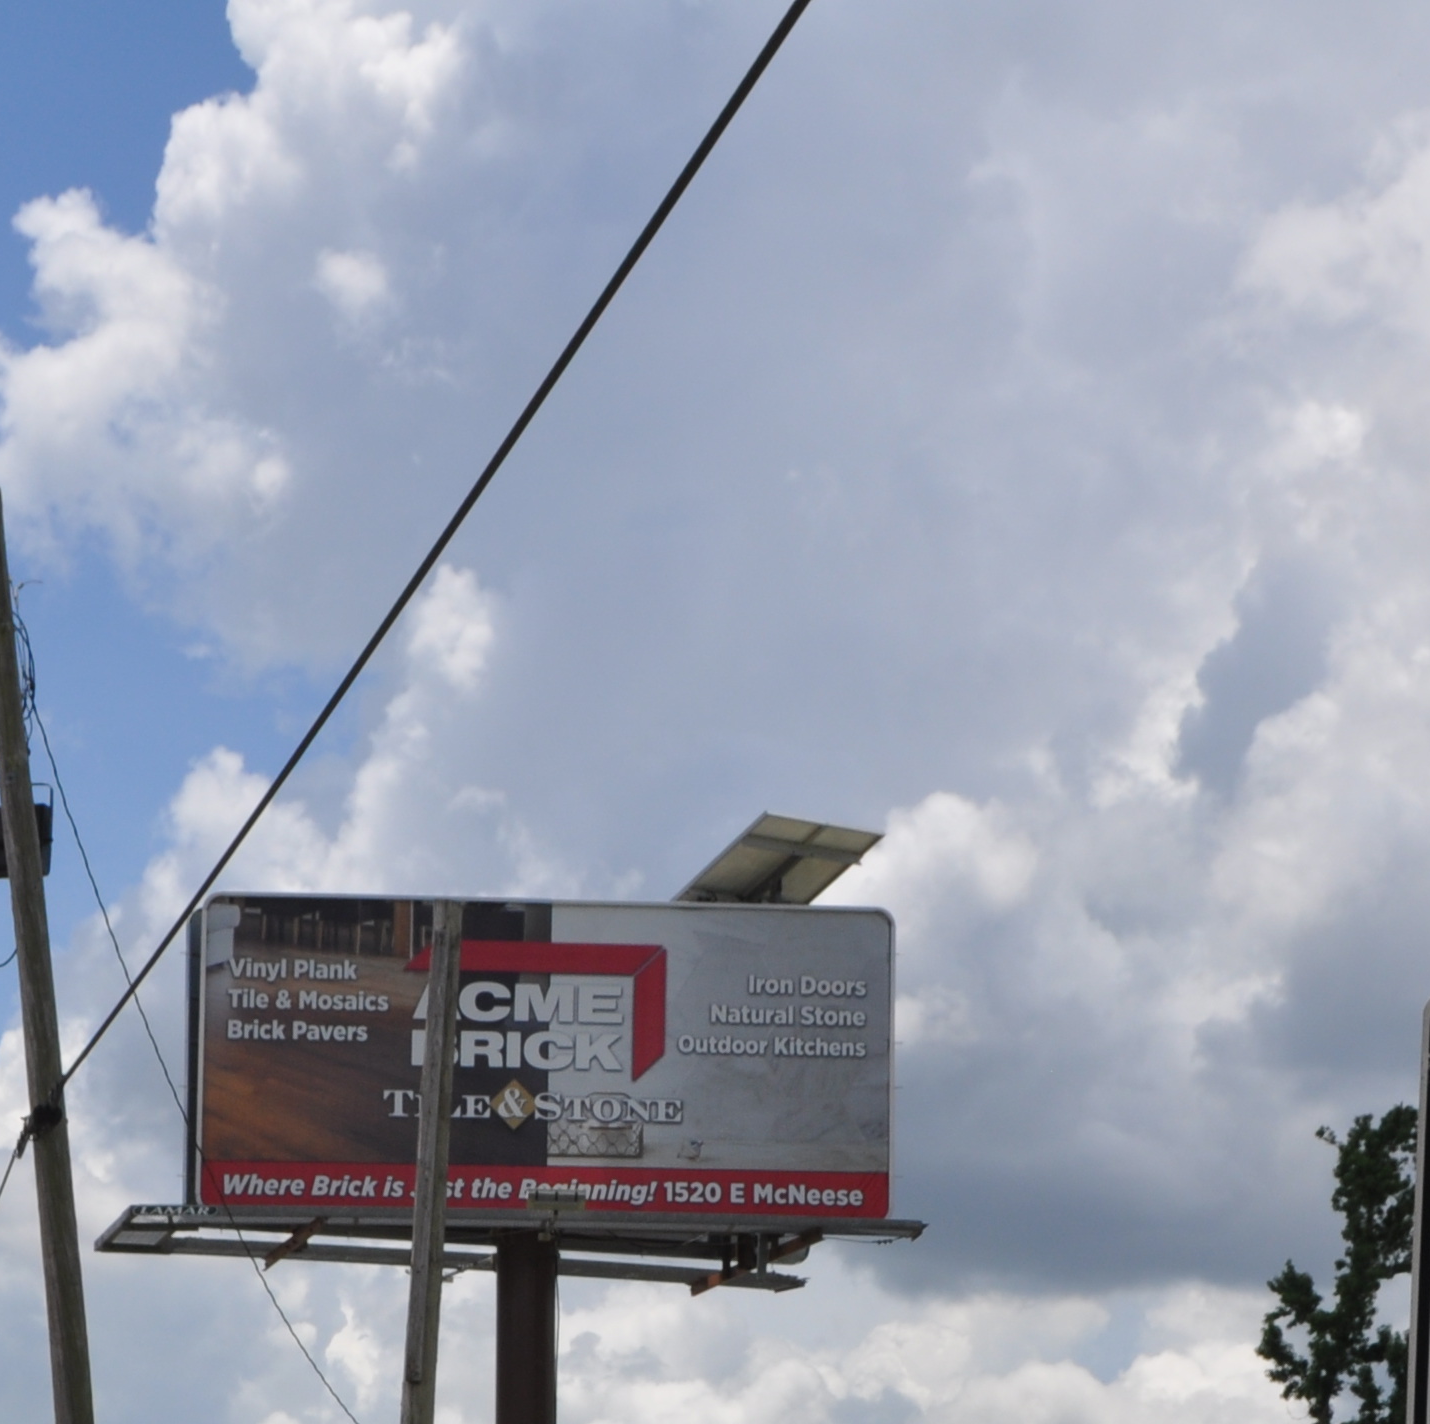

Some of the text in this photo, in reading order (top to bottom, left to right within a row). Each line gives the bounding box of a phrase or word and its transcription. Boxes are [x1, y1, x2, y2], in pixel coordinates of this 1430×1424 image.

[228, 958, 357, 982] Vinyl Plank
[748, 975, 867, 996] Iron Doors
[228, 988, 390, 1011] Tile & Mosaics
[710, 1004, 866, 1026] Natural Stone
[227, 1019, 368, 1042] Brick Pavers
[677, 1034, 866, 1057] Outdoor Kitchens
[383, 1086, 684, 1124] TE & STONE
[222, 1173, 305, 1196] Where
[311, 1174, 376, 1197] Brick
[382, 1175, 405, 1198] is
[471, 1178, 513, 1199] the
[663, 1181, 722, 1203] 1520
[730, 1182, 745, 1204] E
[753, 1183, 863, 1206] McNeese
[140, 1205, 211, 1216] LAMAR
